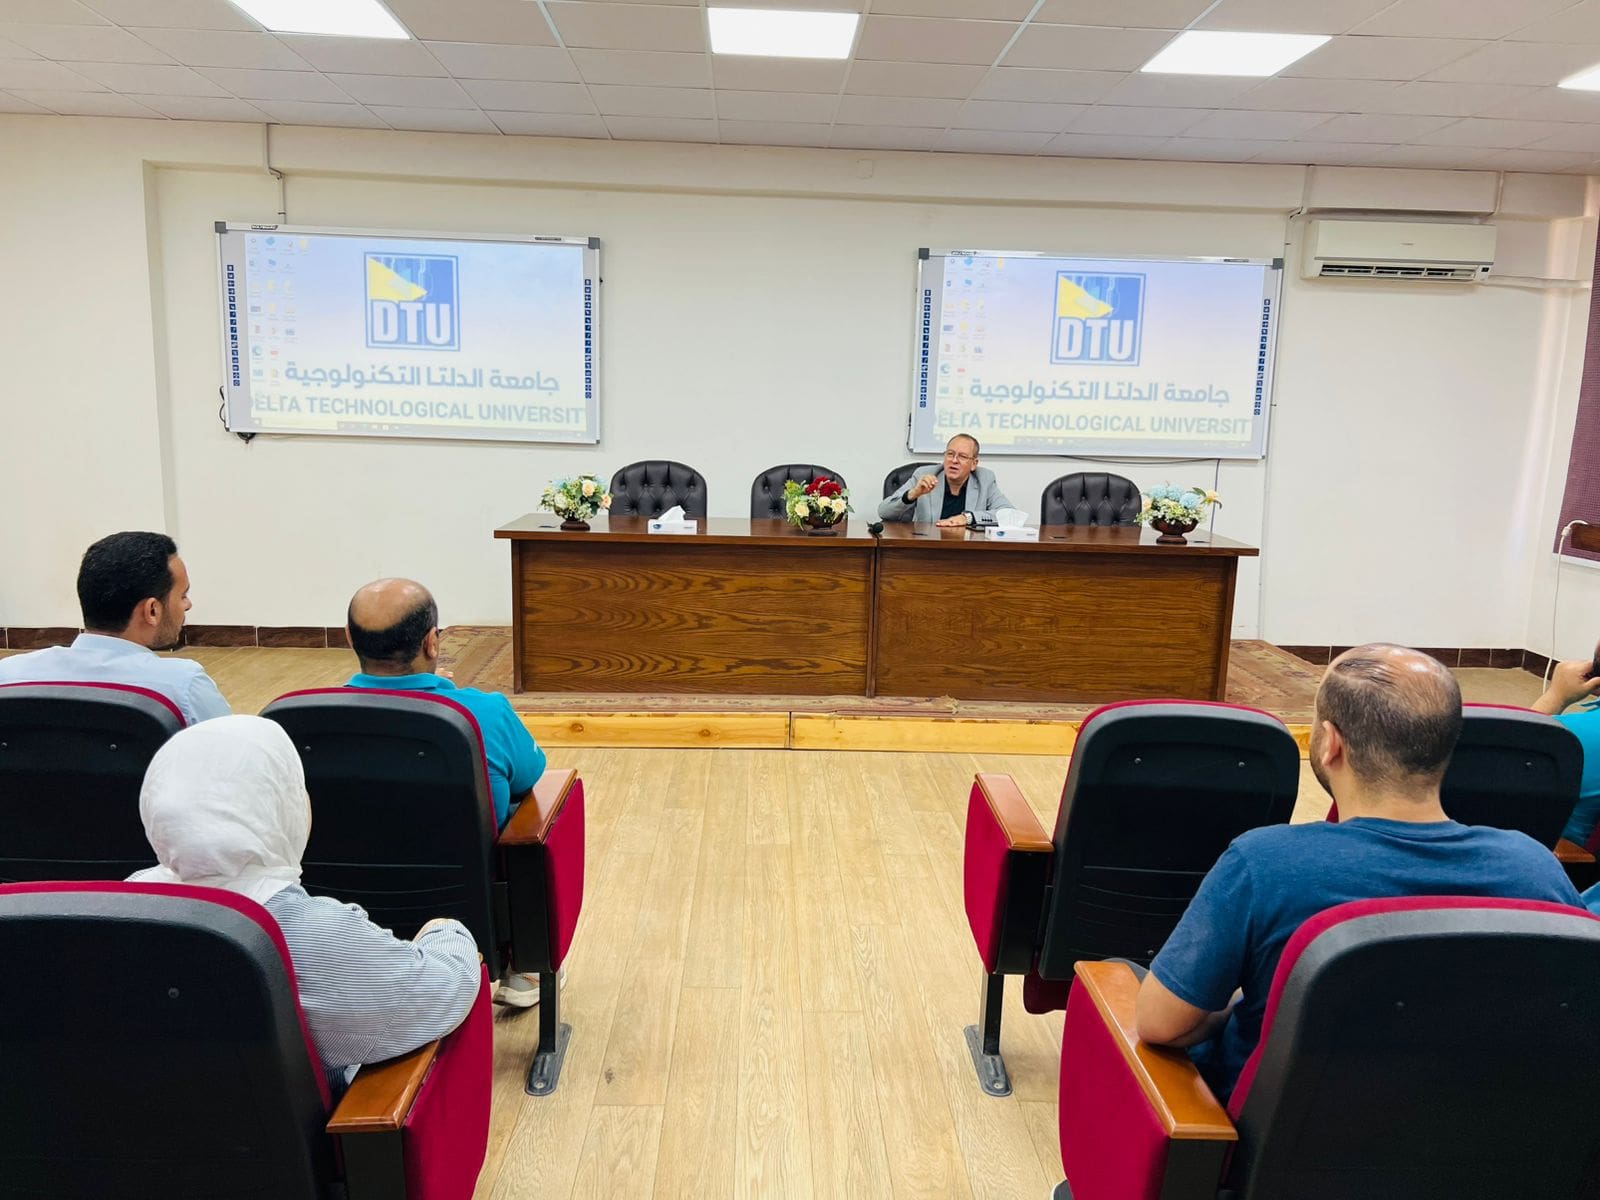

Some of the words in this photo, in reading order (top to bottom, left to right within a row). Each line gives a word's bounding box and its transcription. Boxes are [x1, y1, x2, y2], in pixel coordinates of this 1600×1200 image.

[372, 301, 451, 346] DTU
[1058, 318, 1135, 360] DTU
[284, 360, 421, 390] التكنولوجية
[426, 365, 483, 388] الدلتا
[489, 368, 561, 396] جامعة
[969, 378, 1099, 405] التكنولوجية
[1104, 381, 1159, 402] الدلتا
[1163, 382, 1230, 408] جامعة
[252, 394, 301, 414] ELTA
[306, 396, 474, 421] TECHNOLOGICAL
[478, 403, 585, 424] UNIVERSIT
[936, 411, 982, 429] ELTA
[987, 412, 1145, 432] TECHNOLOGICAL
[1150, 417, 1251, 435] UNIVERSIT
